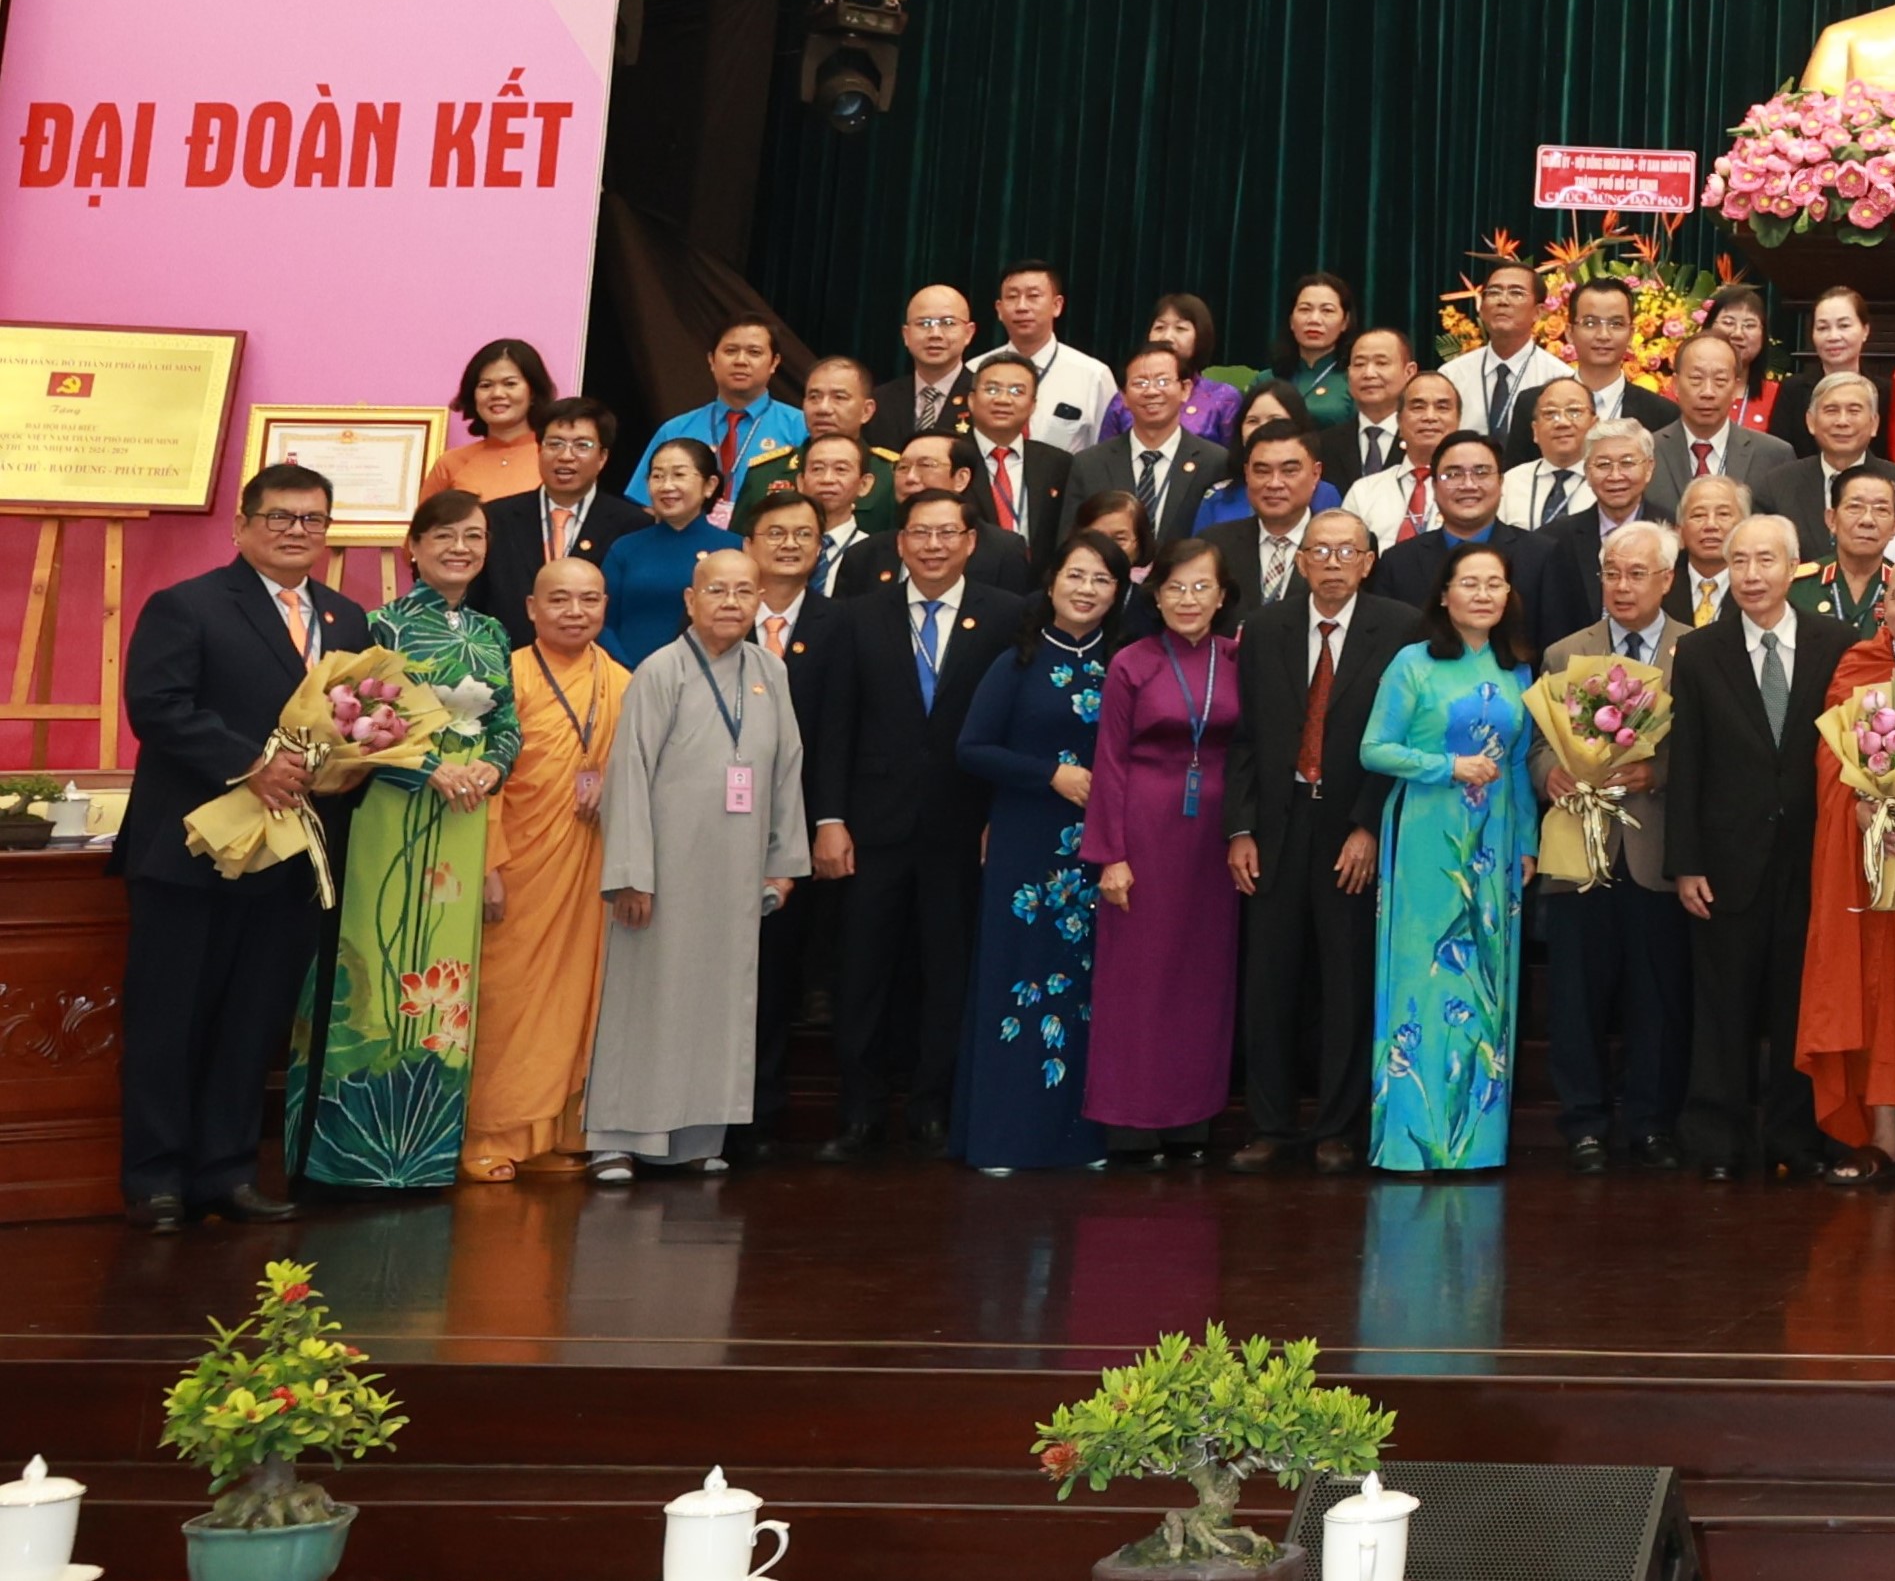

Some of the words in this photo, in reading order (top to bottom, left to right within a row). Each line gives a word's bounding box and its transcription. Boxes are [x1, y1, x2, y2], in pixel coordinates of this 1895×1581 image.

[19, 101, 156, 208] ĐẠI
[184, 84, 401, 189] ĐOÀN
[429, 68, 573, 188] KẾT
